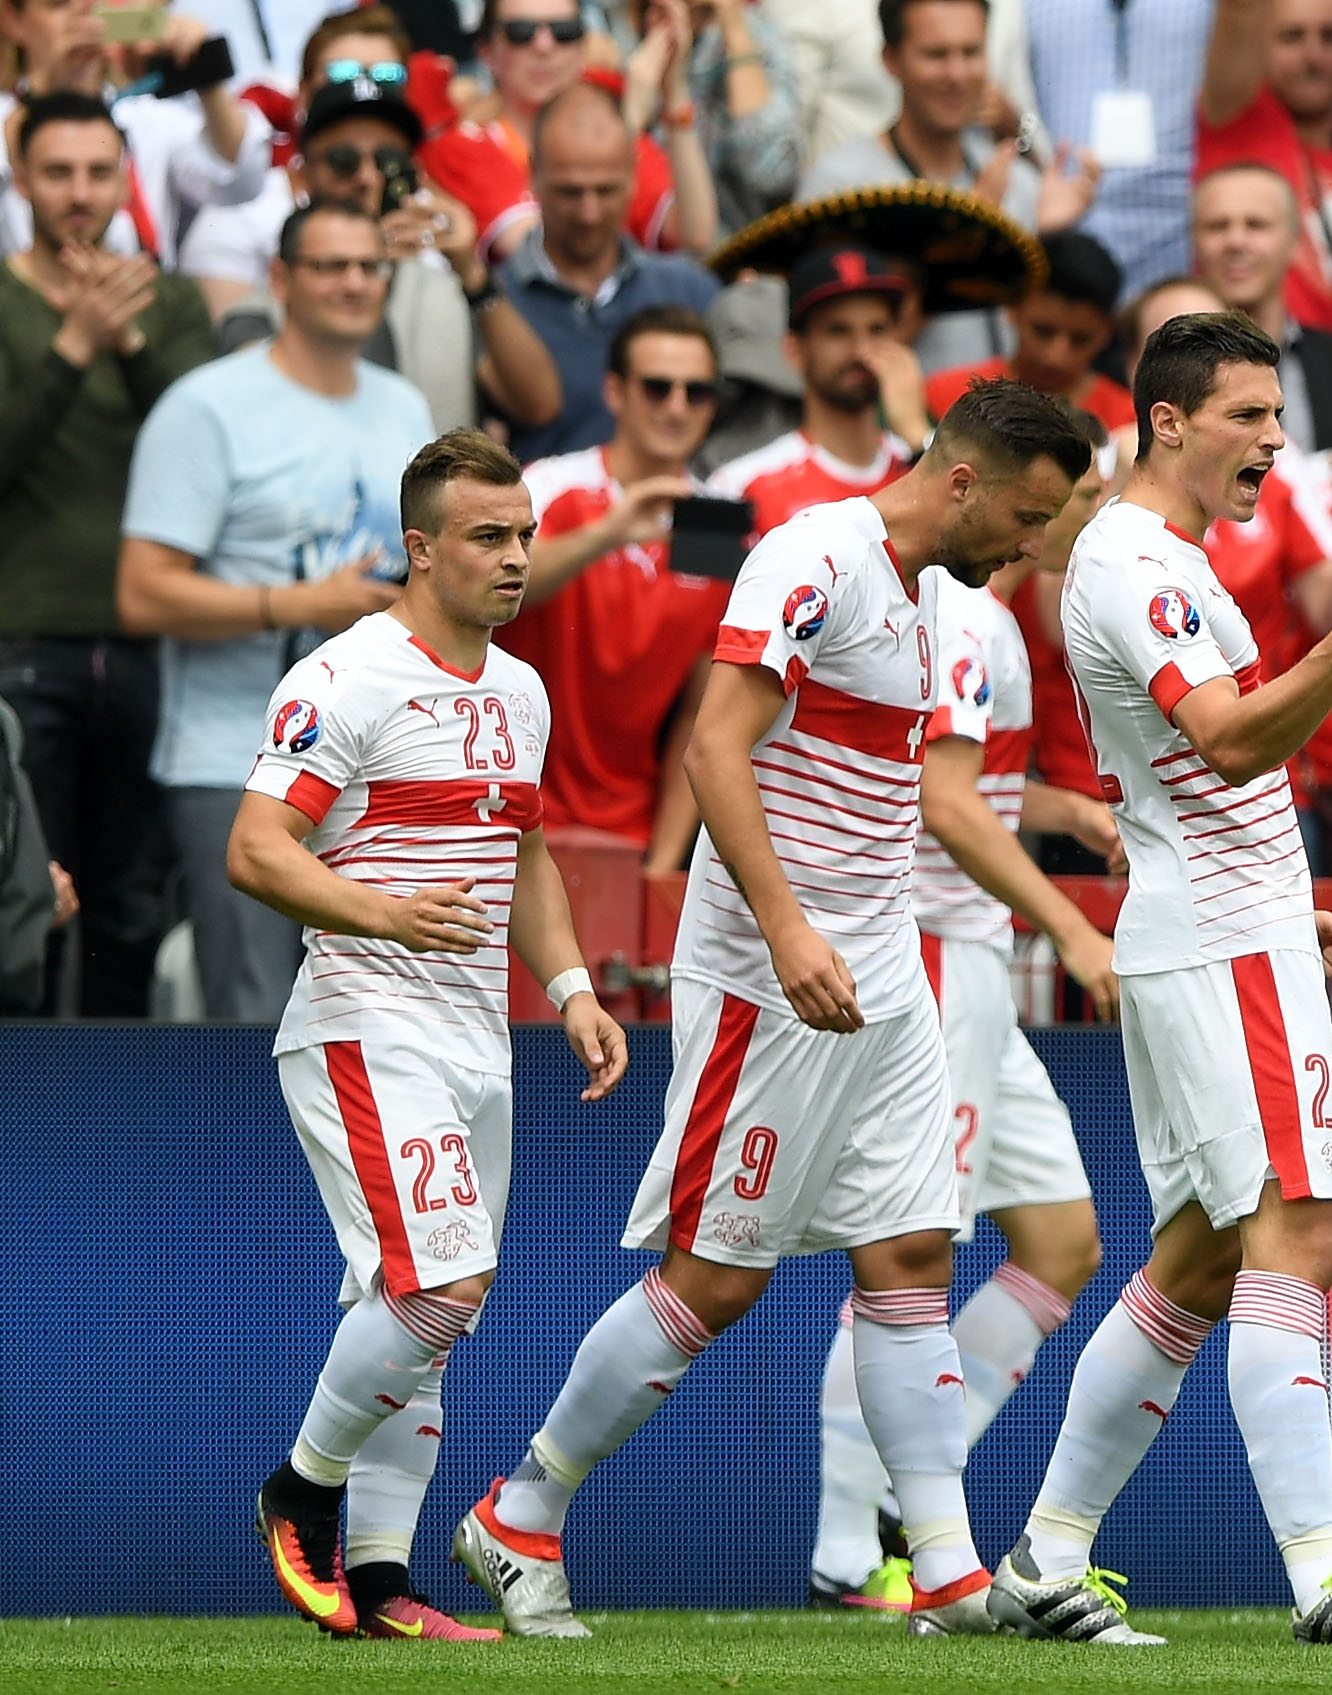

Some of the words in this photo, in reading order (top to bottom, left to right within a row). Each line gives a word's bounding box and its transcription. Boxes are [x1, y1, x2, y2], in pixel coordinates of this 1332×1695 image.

[917, 625, 932, 701] 9
[454, 698, 516, 770] 23
[400, 1134, 477, 1213] 23
[734, 1126, 779, 1200] 9
